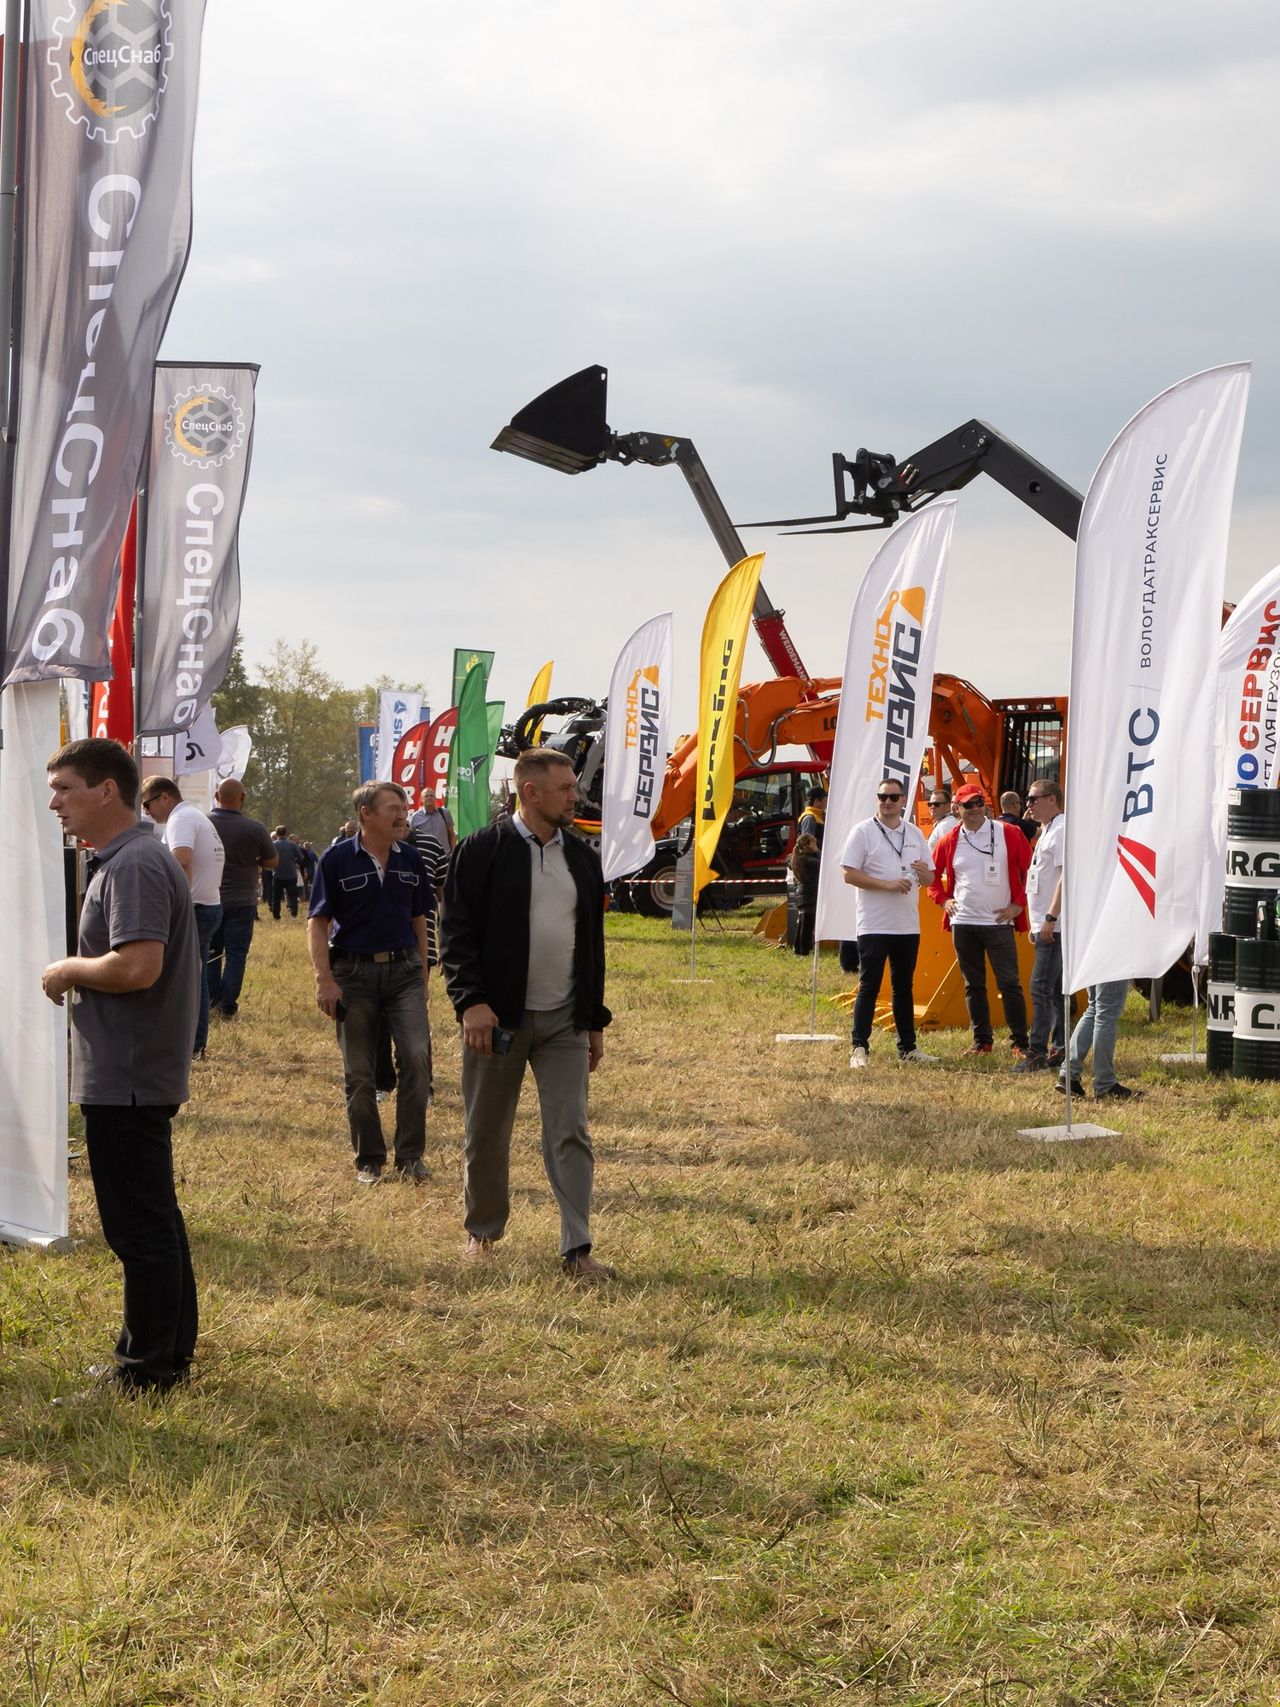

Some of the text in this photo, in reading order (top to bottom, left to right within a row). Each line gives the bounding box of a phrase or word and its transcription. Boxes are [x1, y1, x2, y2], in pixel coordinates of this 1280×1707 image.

[83, 43, 161, 68] СпецСнаб
[181, 420, 233, 434] СпецСнаб
[173, 482, 225, 725] СпецСнаб
[1122, 452, 1169, 823] ВТС ВОЛОГДАТРАКСЕРВИС
[624, 686, 638, 750] ТЕХНО
[866, 618, 891, 722] ТЕХНО
[882, 621, 922, 800] РВИС
[393, 718, 403, 751] SIT
[633, 687, 660, 819] СЕРВИС
